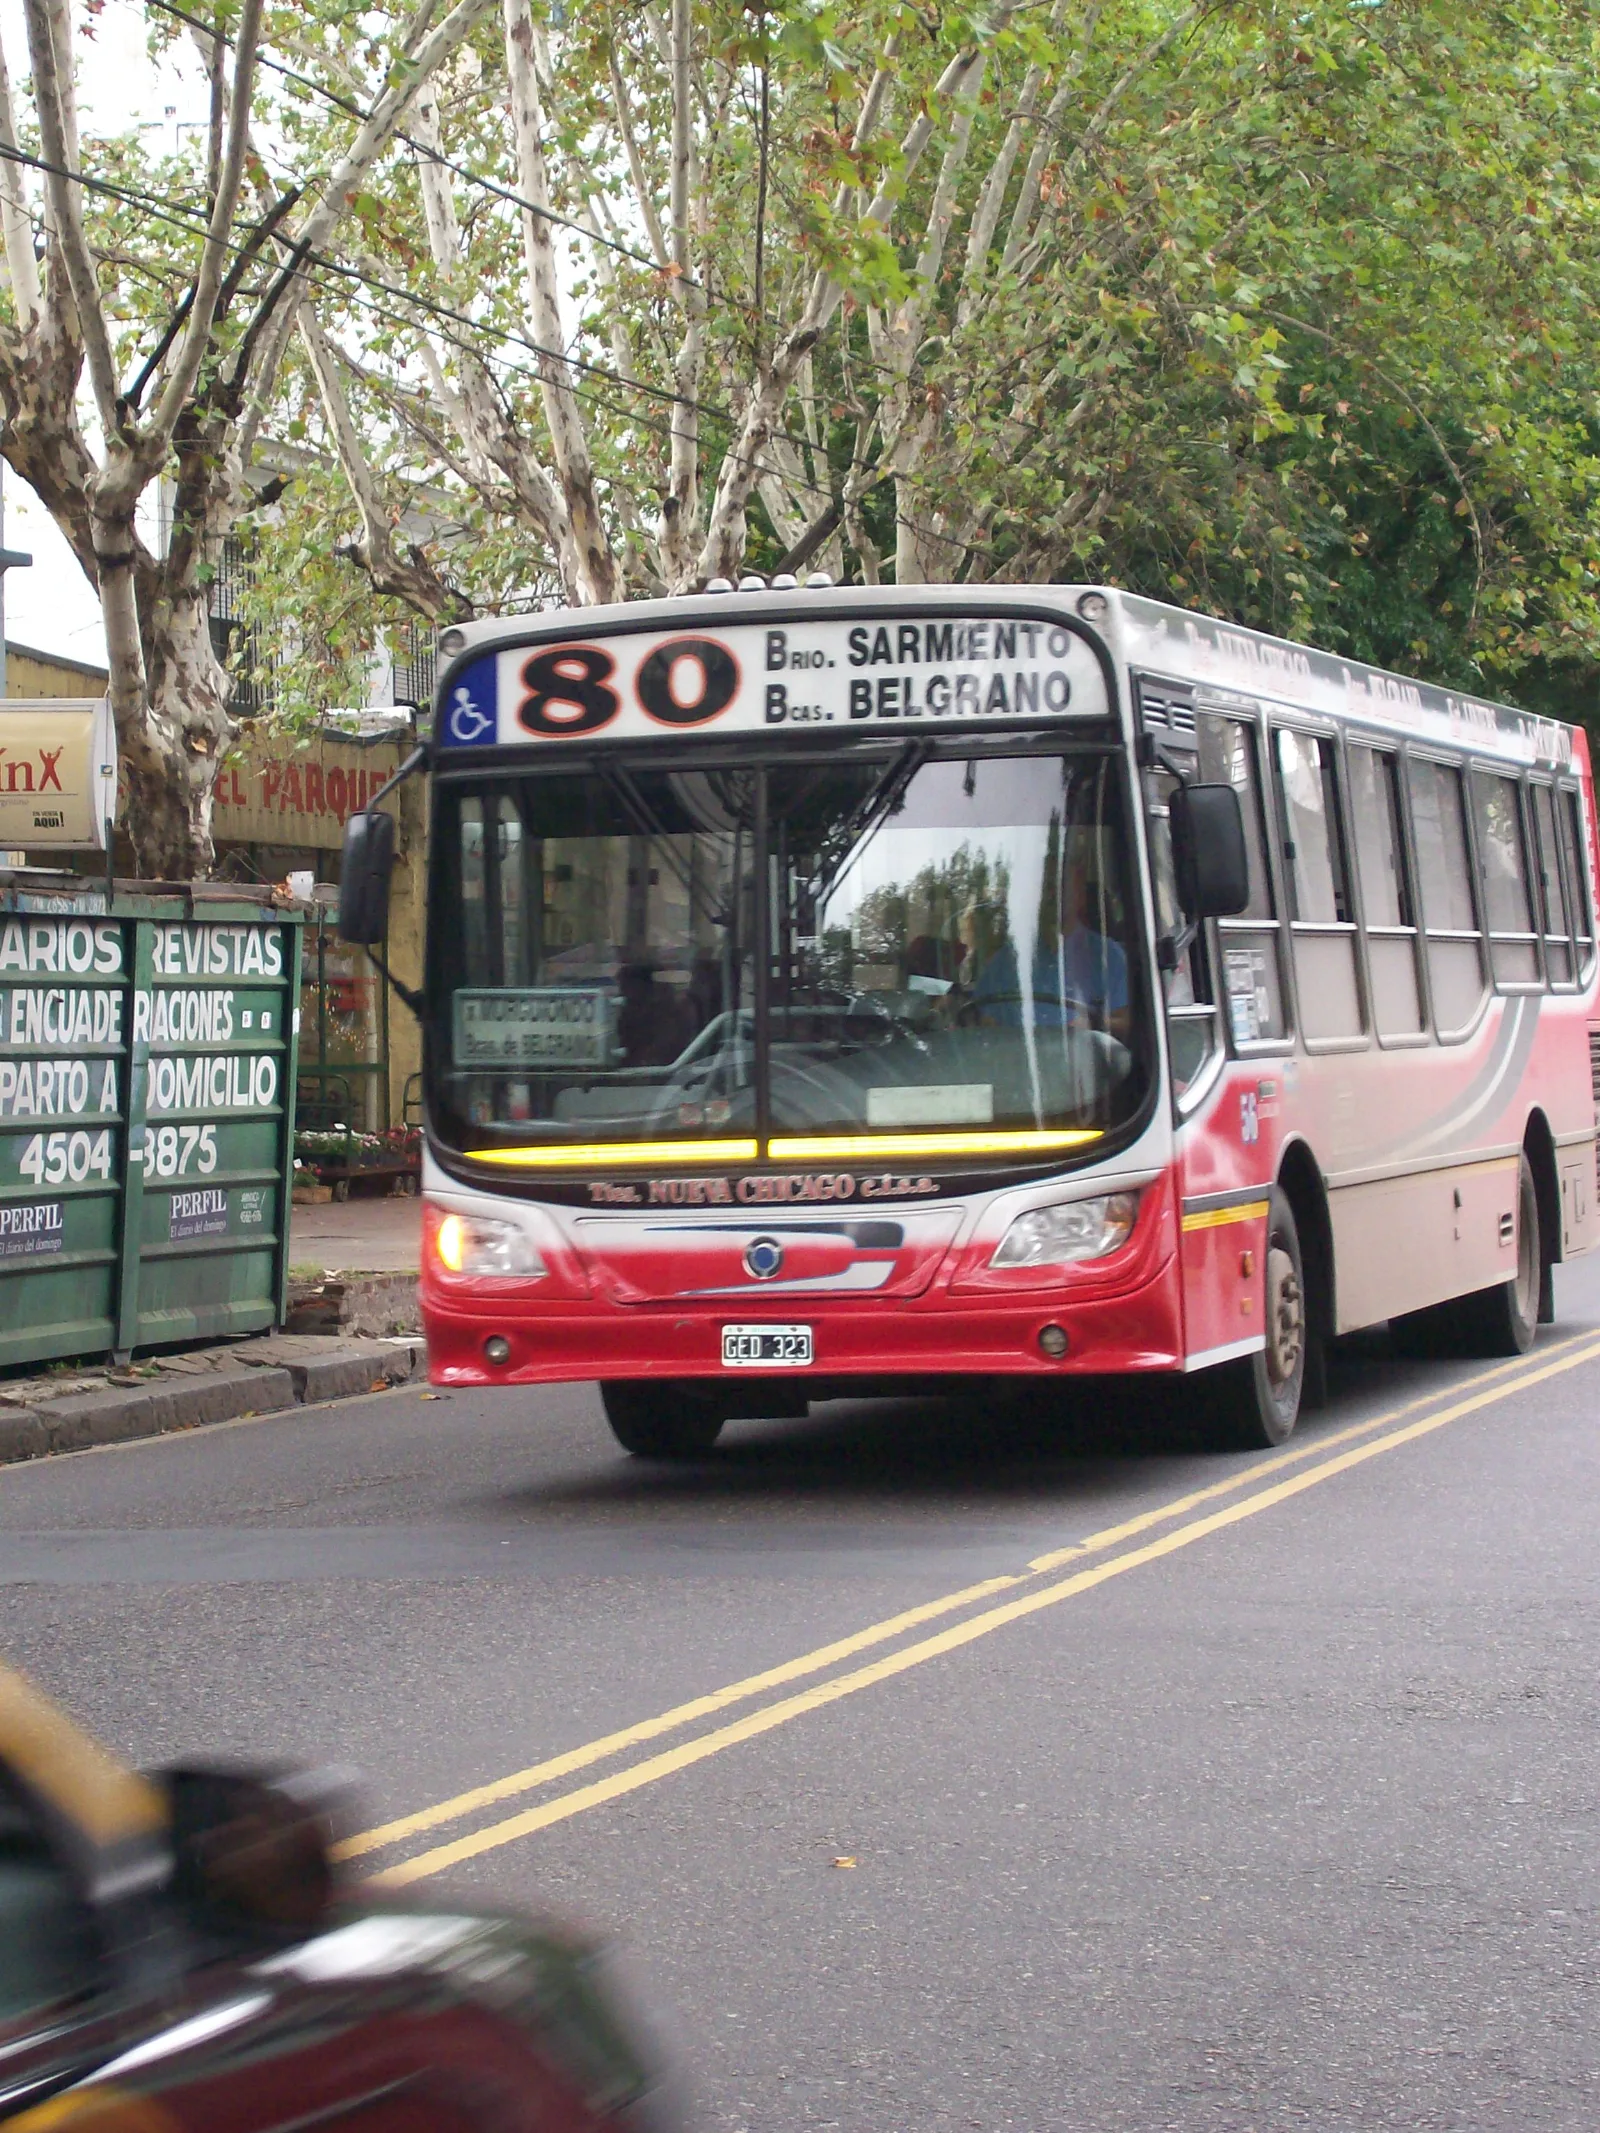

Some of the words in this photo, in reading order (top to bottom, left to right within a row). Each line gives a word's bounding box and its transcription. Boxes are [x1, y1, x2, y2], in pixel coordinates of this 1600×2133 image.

[848, 621, 1070, 667] SARMIENTO
[517, 634, 742, 738] 80
[849, 670, 1071, 719] BELGRANO
[0, 920, 122, 974] ARIOS
[100, 1059, 118, 1113] A
[171, 1188, 227, 1219] PERFIL
[649, 1178, 733, 1203] NUEVA
[736, 1174, 856, 1203] CHICAGO
[0, 1203, 63, 1235] PERFIL
[725, 1336, 762, 1358] GED
[772, 1336, 808, 1358] 323
